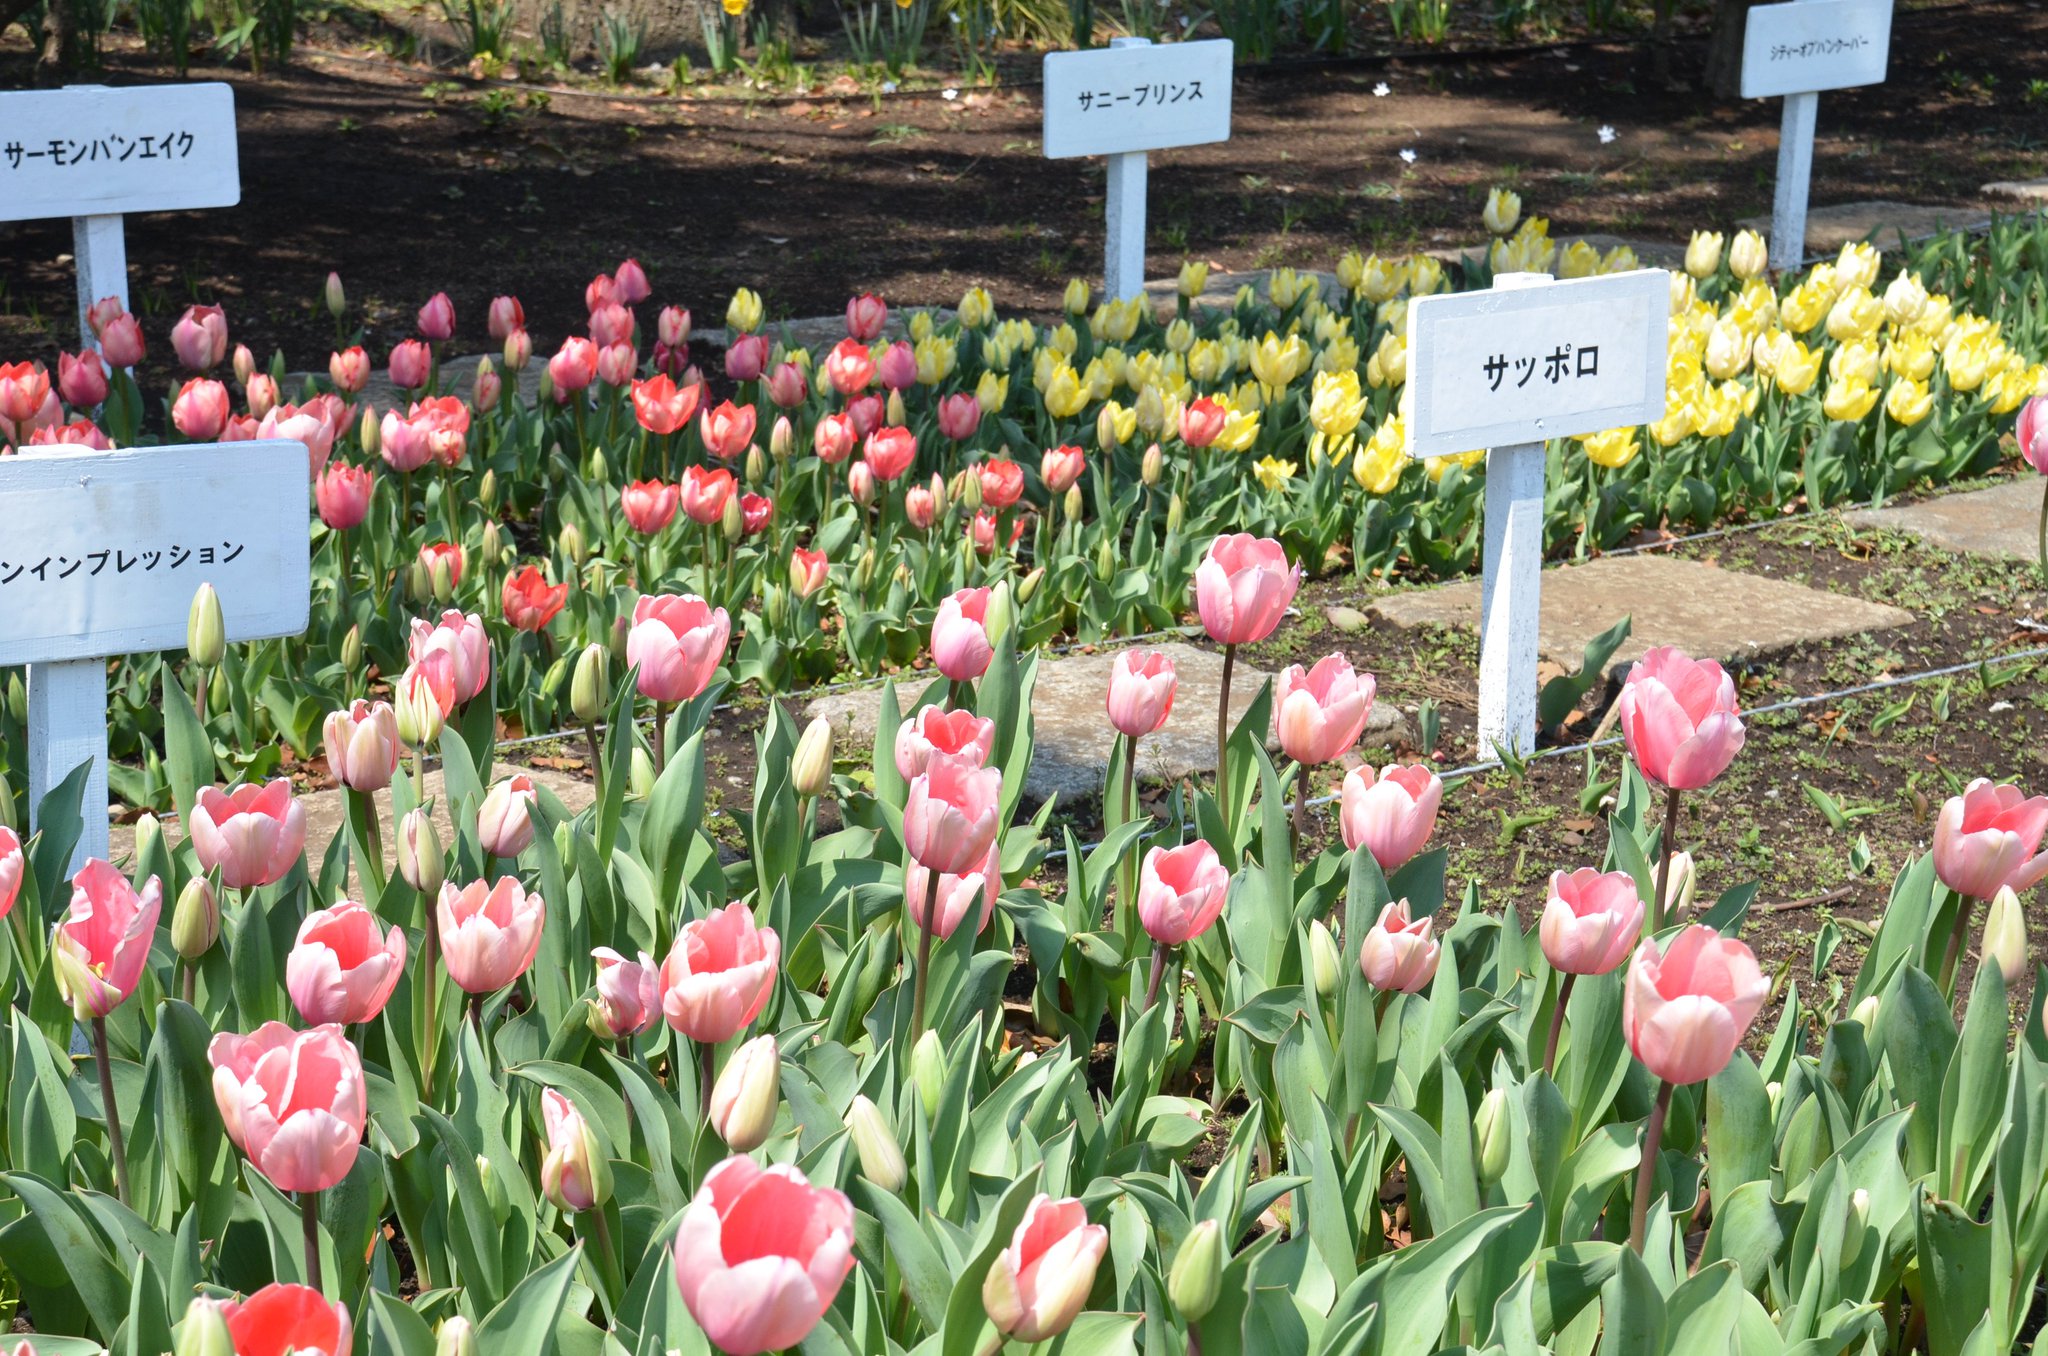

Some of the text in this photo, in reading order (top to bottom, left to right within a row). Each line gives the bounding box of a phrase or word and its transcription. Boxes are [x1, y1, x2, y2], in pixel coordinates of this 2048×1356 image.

[1078, 80, 1204, 112] サニープリンス
[3, 129, 194, 170] サーモンバンエイク
[1483, 342, 1600, 392] サッポロ
[0, 541, 245, 586] ンインプレッション
